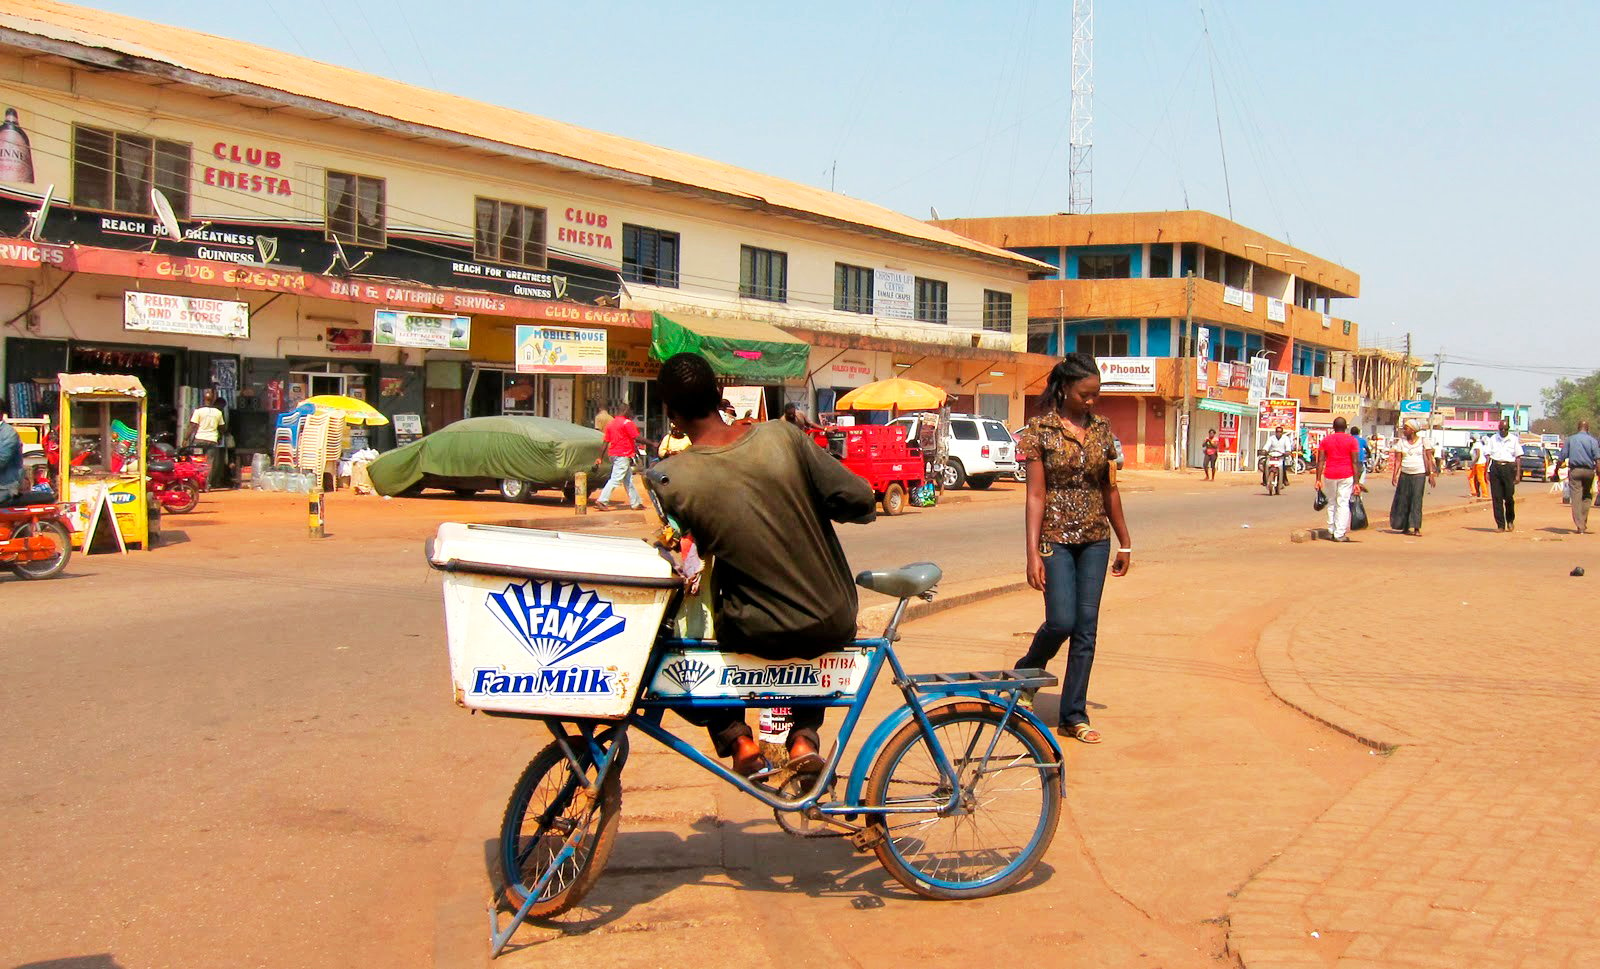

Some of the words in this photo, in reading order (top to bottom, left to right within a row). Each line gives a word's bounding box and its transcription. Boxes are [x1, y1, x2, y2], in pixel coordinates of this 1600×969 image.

[213, 142, 281, 169] CLUB
[204, 167, 292, 196] ENESTA
[565, 207, 608, 228] CLUB
[102, 218, 145, 233] REACH
[185, 229, 254, 246] GREATNESS
[558, 227, 613, 249] ENESTA
[197, 246, 255, 263] GUINNESS
[156, 262, 215, 279] CLUB
[452, 262, 481, 274] REACH
[485, 267, 502, 278] FOR
[506, 270, 552, 284] GREATNESS
[875, 271, 902, 282] CHRISTIAN
[331, 281, 359, 297] BAR
[366, 286, 380, 299] &
[386, 288, 445, 305] CATERING
[454, 295, 506, 311] SERVICES
[514, 284, 552, 299] GUINNESS
[144, 295, 179, 308] RELAX
[147, 307, 172, 319] AND
[180, 311, 221, 323] STORES
[545, 306, 581, 320] CLUB
[585, 310, 636, 324] ENESTA
[534, 330, 571, 340] MOBILE
[574, 331, 604, 342] HOUSE
[1110, 364, 1150, 374] Phoenix
[529, 607, 583, 642] FAN
[679, 669, 701, 683] FAN
[821, 674, 831, 688] 6
